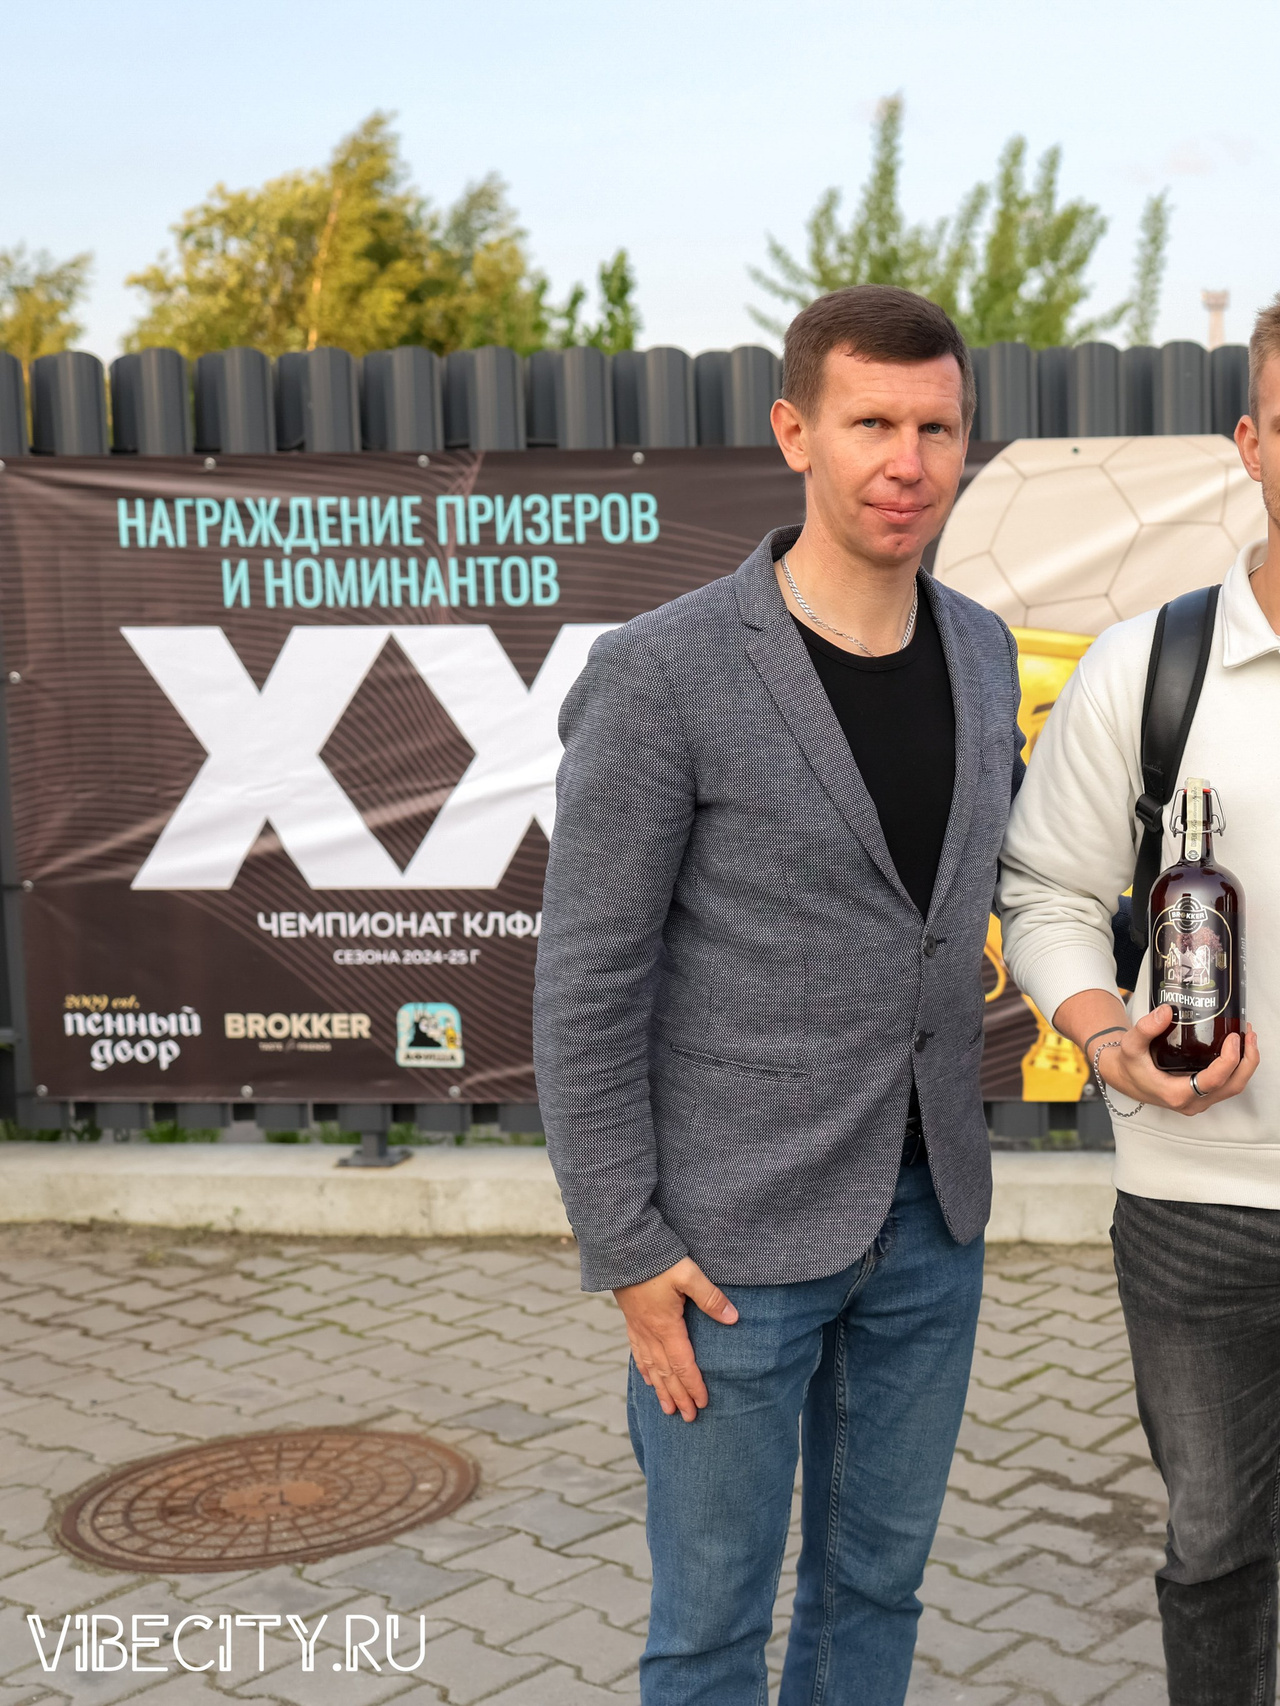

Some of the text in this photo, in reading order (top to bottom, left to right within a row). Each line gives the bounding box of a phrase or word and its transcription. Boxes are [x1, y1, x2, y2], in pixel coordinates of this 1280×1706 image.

[116, 492, 661, 555] НАГРАЖДЕНИЕ ПРИЗЕРОВ
[220, 555, 561, 609] И НОМИНАНТОВ
[256, 910, 458, 939] ЧЕМПИОНАТ
[332, 948, 401, 965] СЕЗОНА
[402, 949, 469, 965] 2024-25
[1160, 989, 1216, 1008] Лихтенхаген
[224, 1013, 371, 1039] BROKKER
